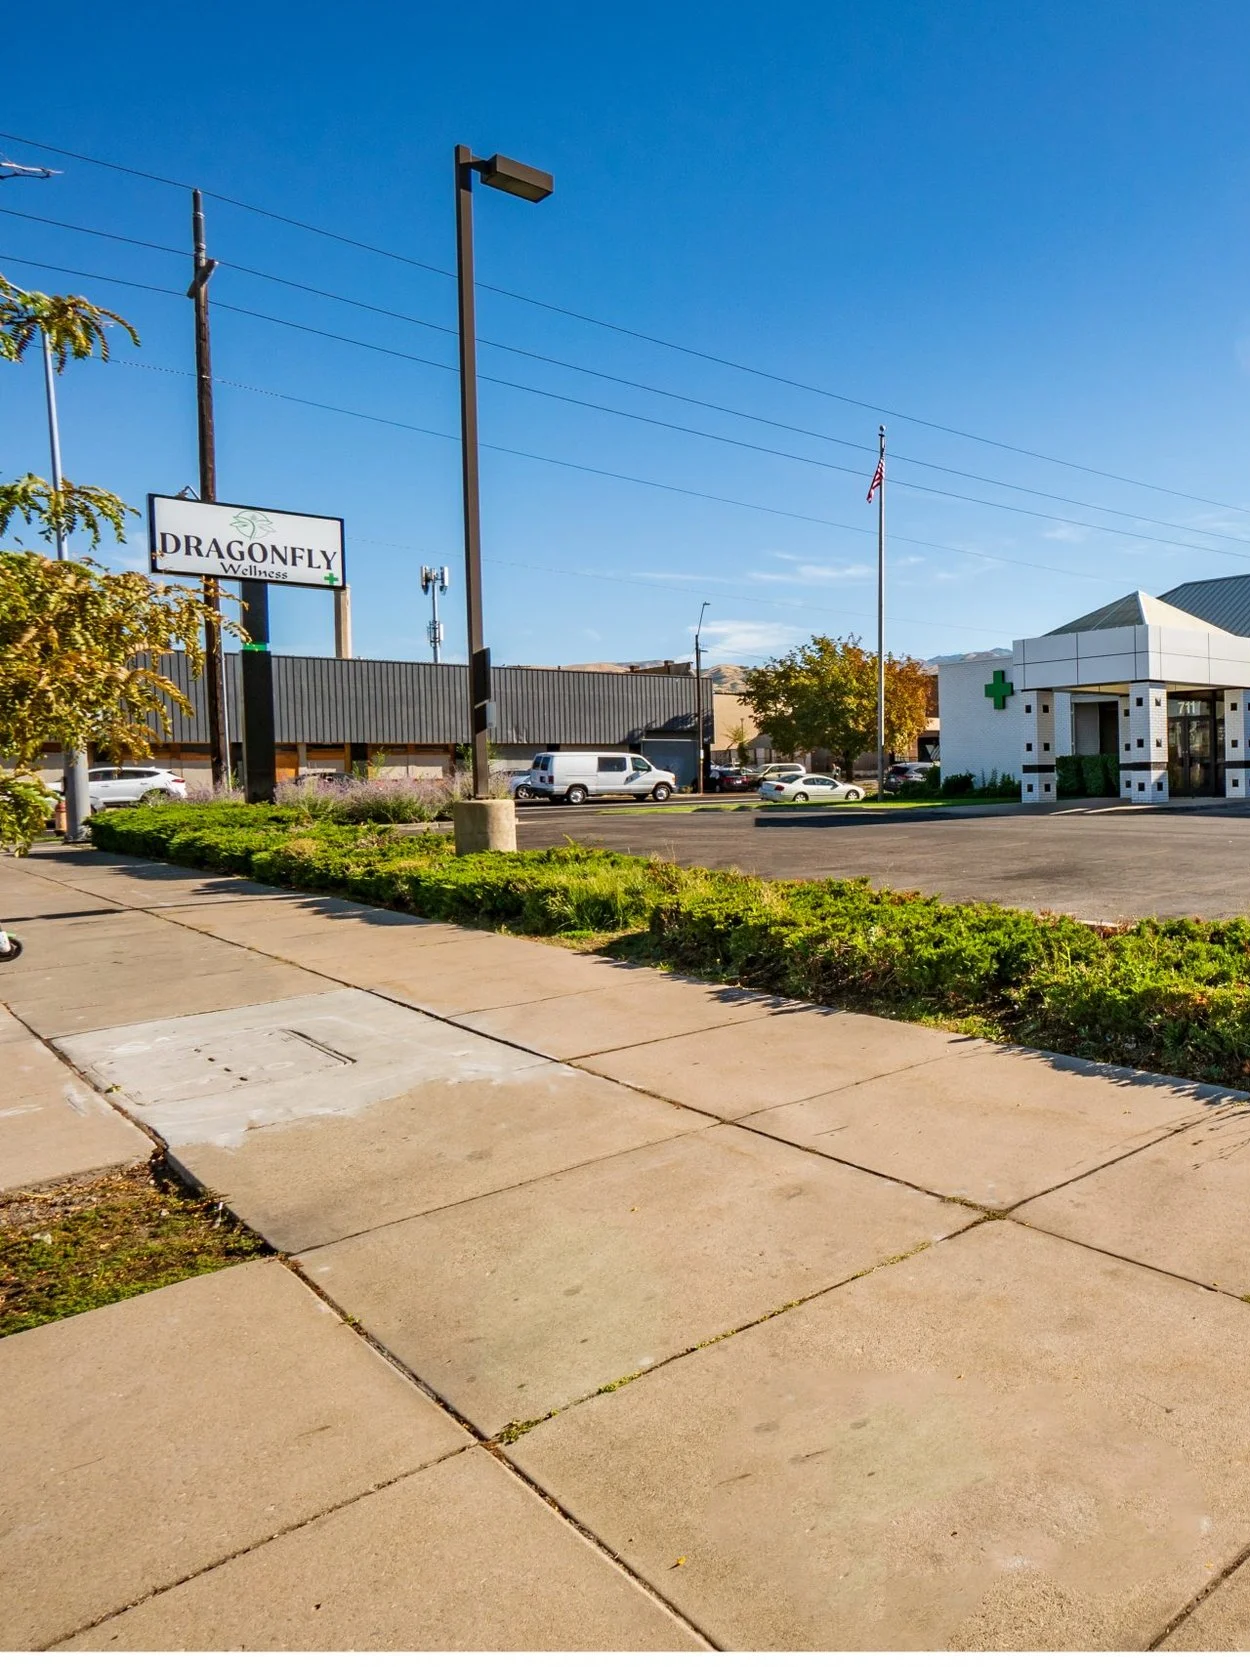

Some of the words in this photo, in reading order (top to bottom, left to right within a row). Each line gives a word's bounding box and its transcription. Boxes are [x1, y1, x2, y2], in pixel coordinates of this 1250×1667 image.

[160, 532, 337, 570] DRAGONFLY
[220, 562, 288, 579] Wellness
[1177, 701, 1195, 714] 711
